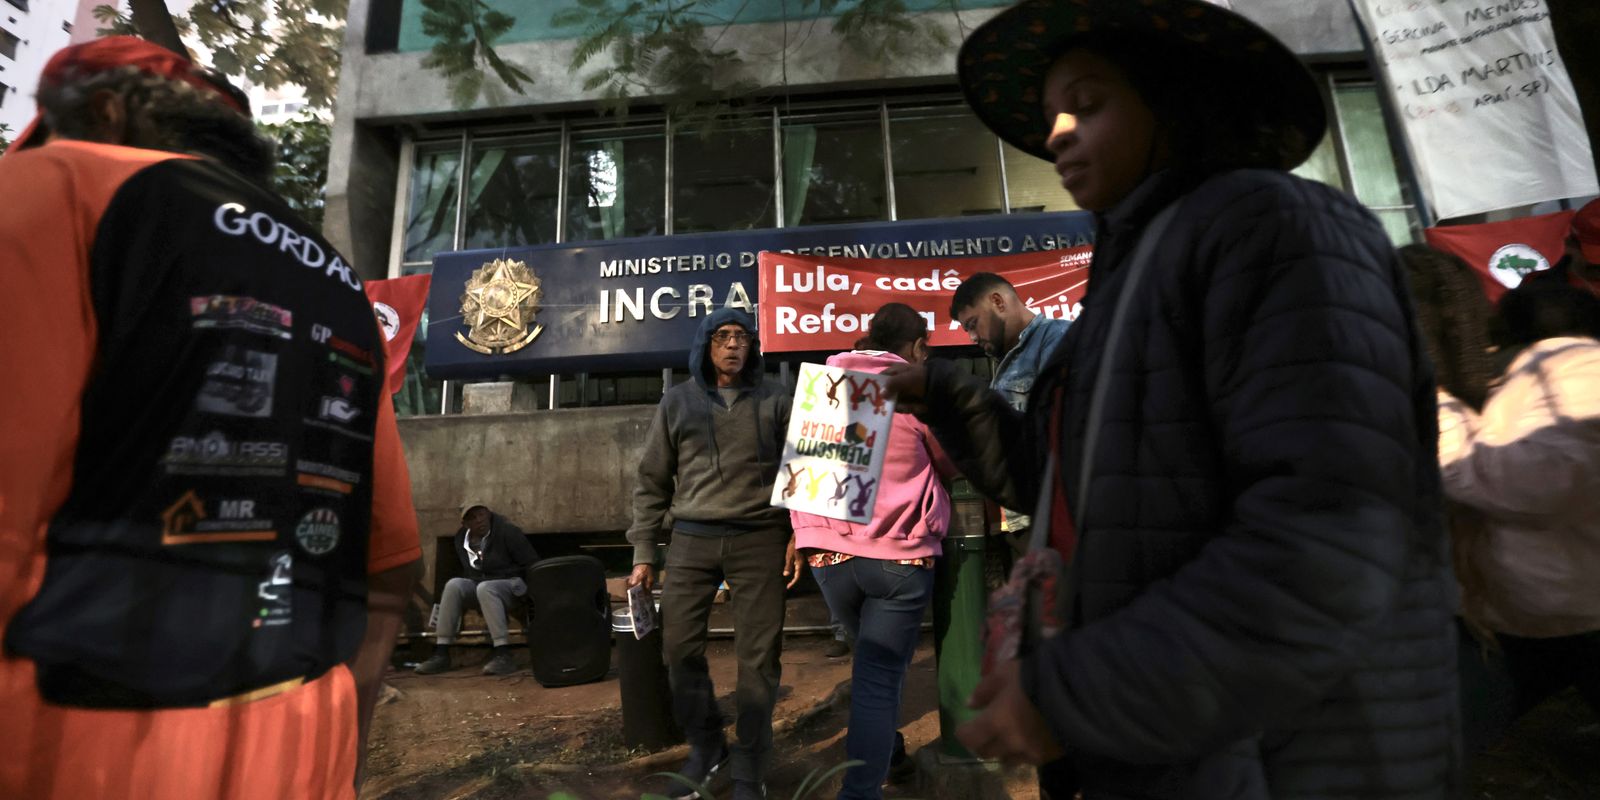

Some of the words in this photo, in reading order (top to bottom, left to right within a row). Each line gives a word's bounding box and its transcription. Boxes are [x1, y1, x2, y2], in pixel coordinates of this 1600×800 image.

[600, 252, 732, 278] MINISTERIO
[1021, 231, 1095, 251] AGRA
[775, 264, 863, 295] Lula,
[875, 269, 962, 291] cadê
[600, 281, 755, 323] INCRA
[775, 303, 936, 335] Refora
[796, 438, 873, 466] PLEBISCITO
[218, 501, 254, 518] MR
